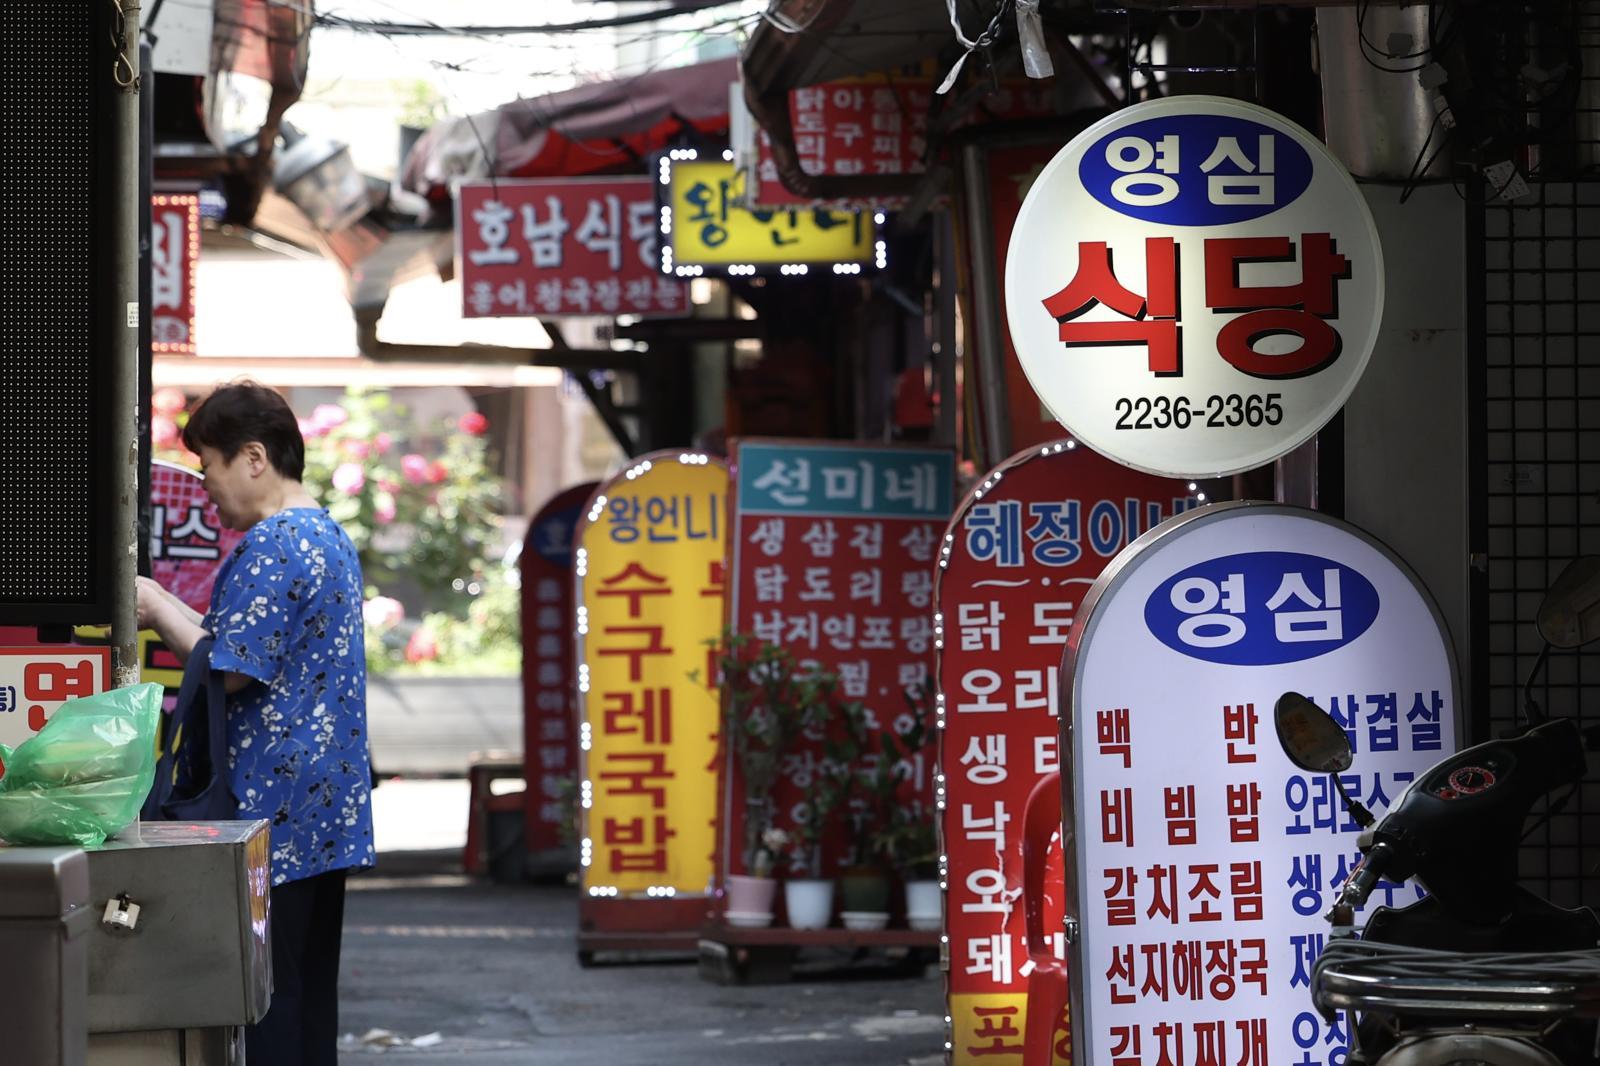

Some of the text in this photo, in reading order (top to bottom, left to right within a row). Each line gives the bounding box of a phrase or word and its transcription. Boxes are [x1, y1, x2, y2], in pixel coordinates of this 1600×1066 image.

[1105, 134, 1275, 206] 영심
[1041, 232, 1352, 380] 식당
[1115, 393, 1283, 430] 2236-2365
[754, 458, 938, 510] 선미네
[607, 494, 718, 543] 왕언니
[964, 498, 1198, 567] 혜정이
[1169, 569, 1344, 648] 영심
[1308, 690, 1444, 755] 삼겹살
[1100, 782, 1262, 848] 비빔밥
[1103, 861, 1264, 927] 갈치조림
[1105, 938, 1268, 1005] 선지해장국
